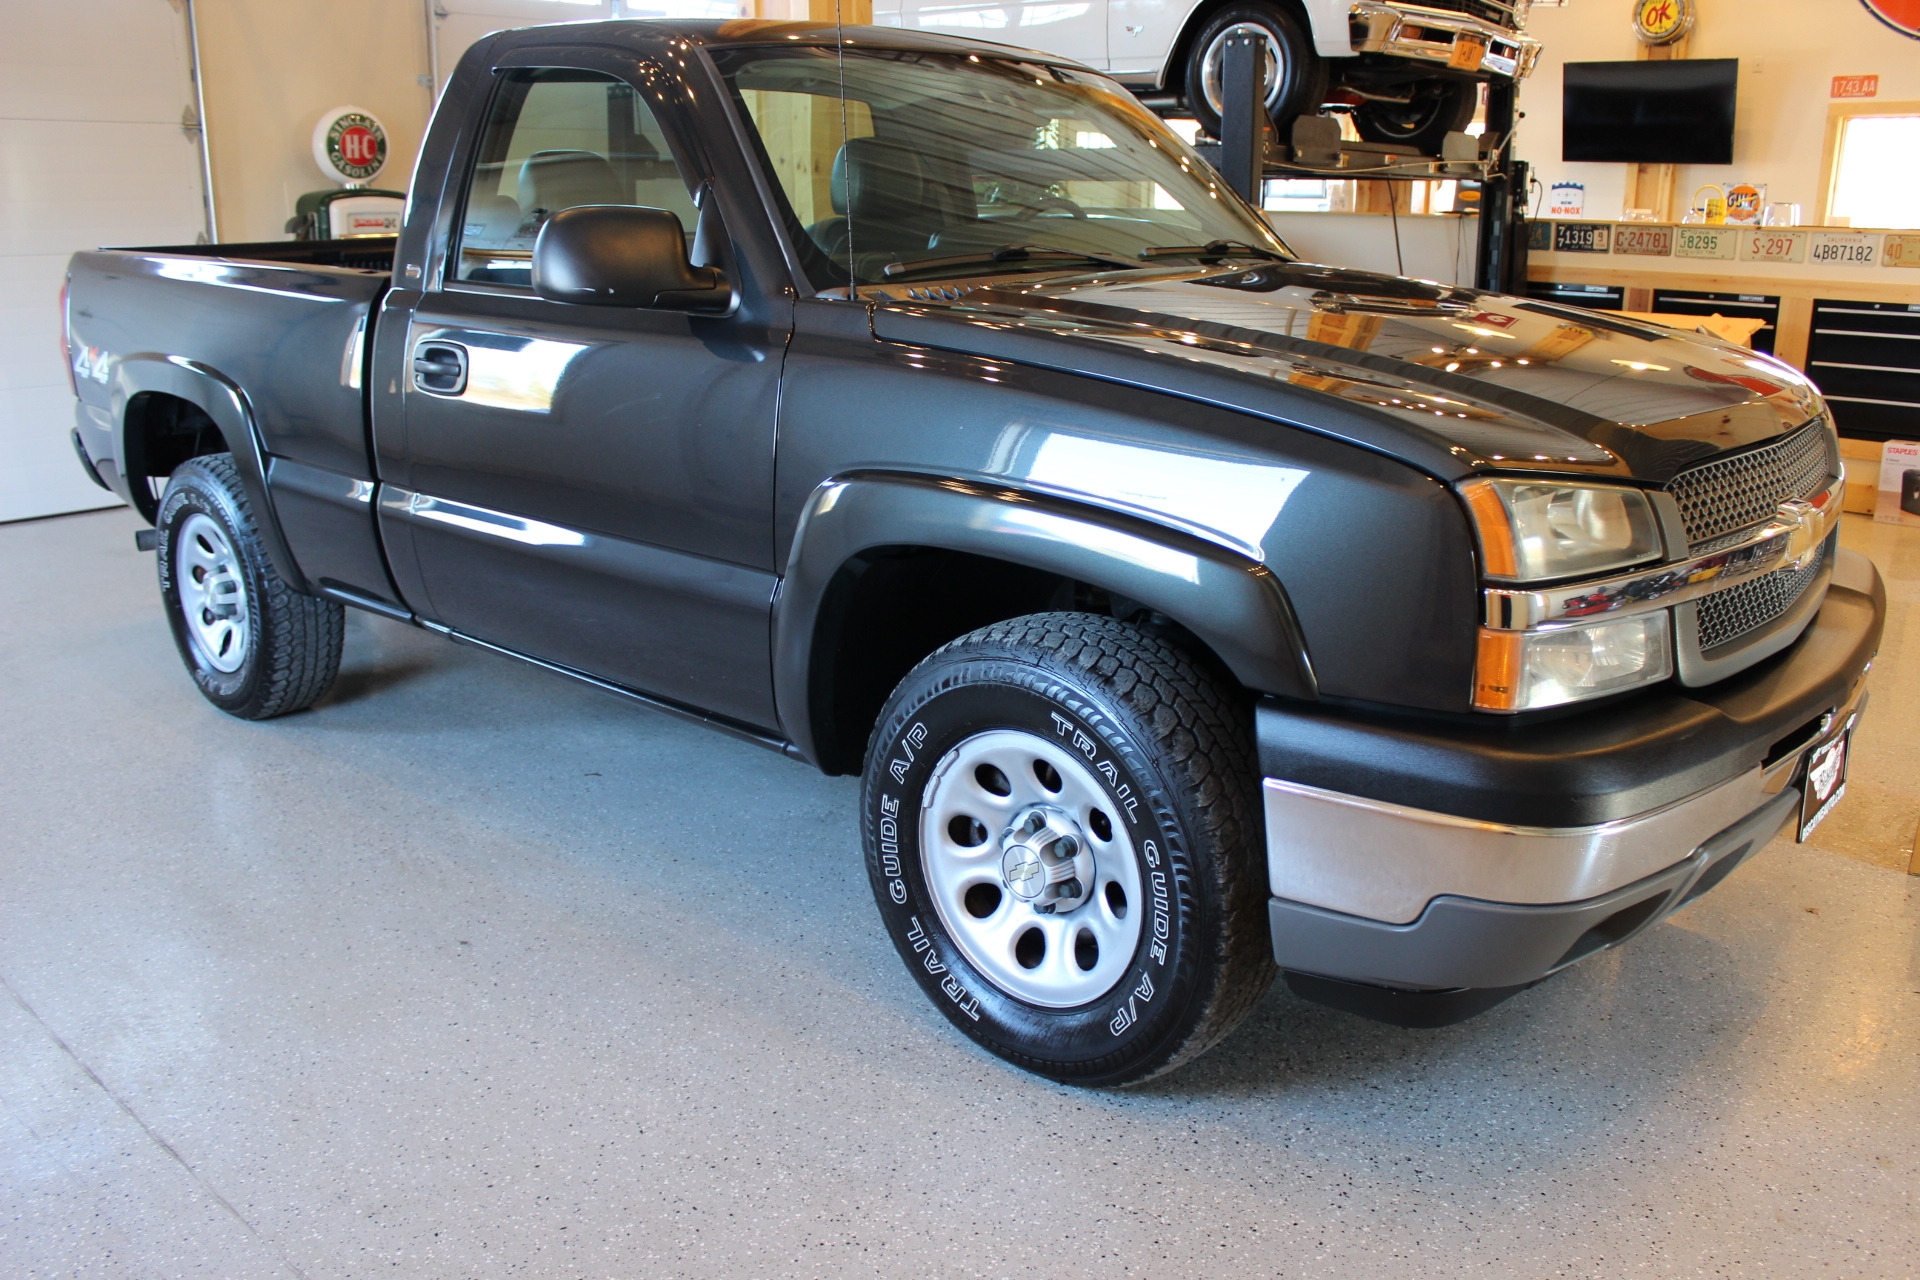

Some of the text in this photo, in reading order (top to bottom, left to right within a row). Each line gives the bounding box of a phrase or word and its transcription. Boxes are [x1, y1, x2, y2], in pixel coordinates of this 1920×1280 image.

[1646, 0, 1672, 27] OK
[1834, 79, 1875, 96] 1743 AA
[330, 114, 383, 141] SINCLAIR
[330, 151, 384, 178] GASOLINE
[1551, 206, 1581, 215] NO-NOX
[1727, 192, 1760, 212] GULF
[1565, 230, 1593, 245] 1319
[1686, 234, 1718, 250] 8295
[1813, 244, 1873, 262] 4B87182
[1887, 447, 1918, 456] STAPLES
[159, 529, 171, 592] TRAIL
[878, 720, 981, 1022] TRAIL GUIDE A/P
[1049, 711, 1170, 1037] TRAIL GUIDE A/P
